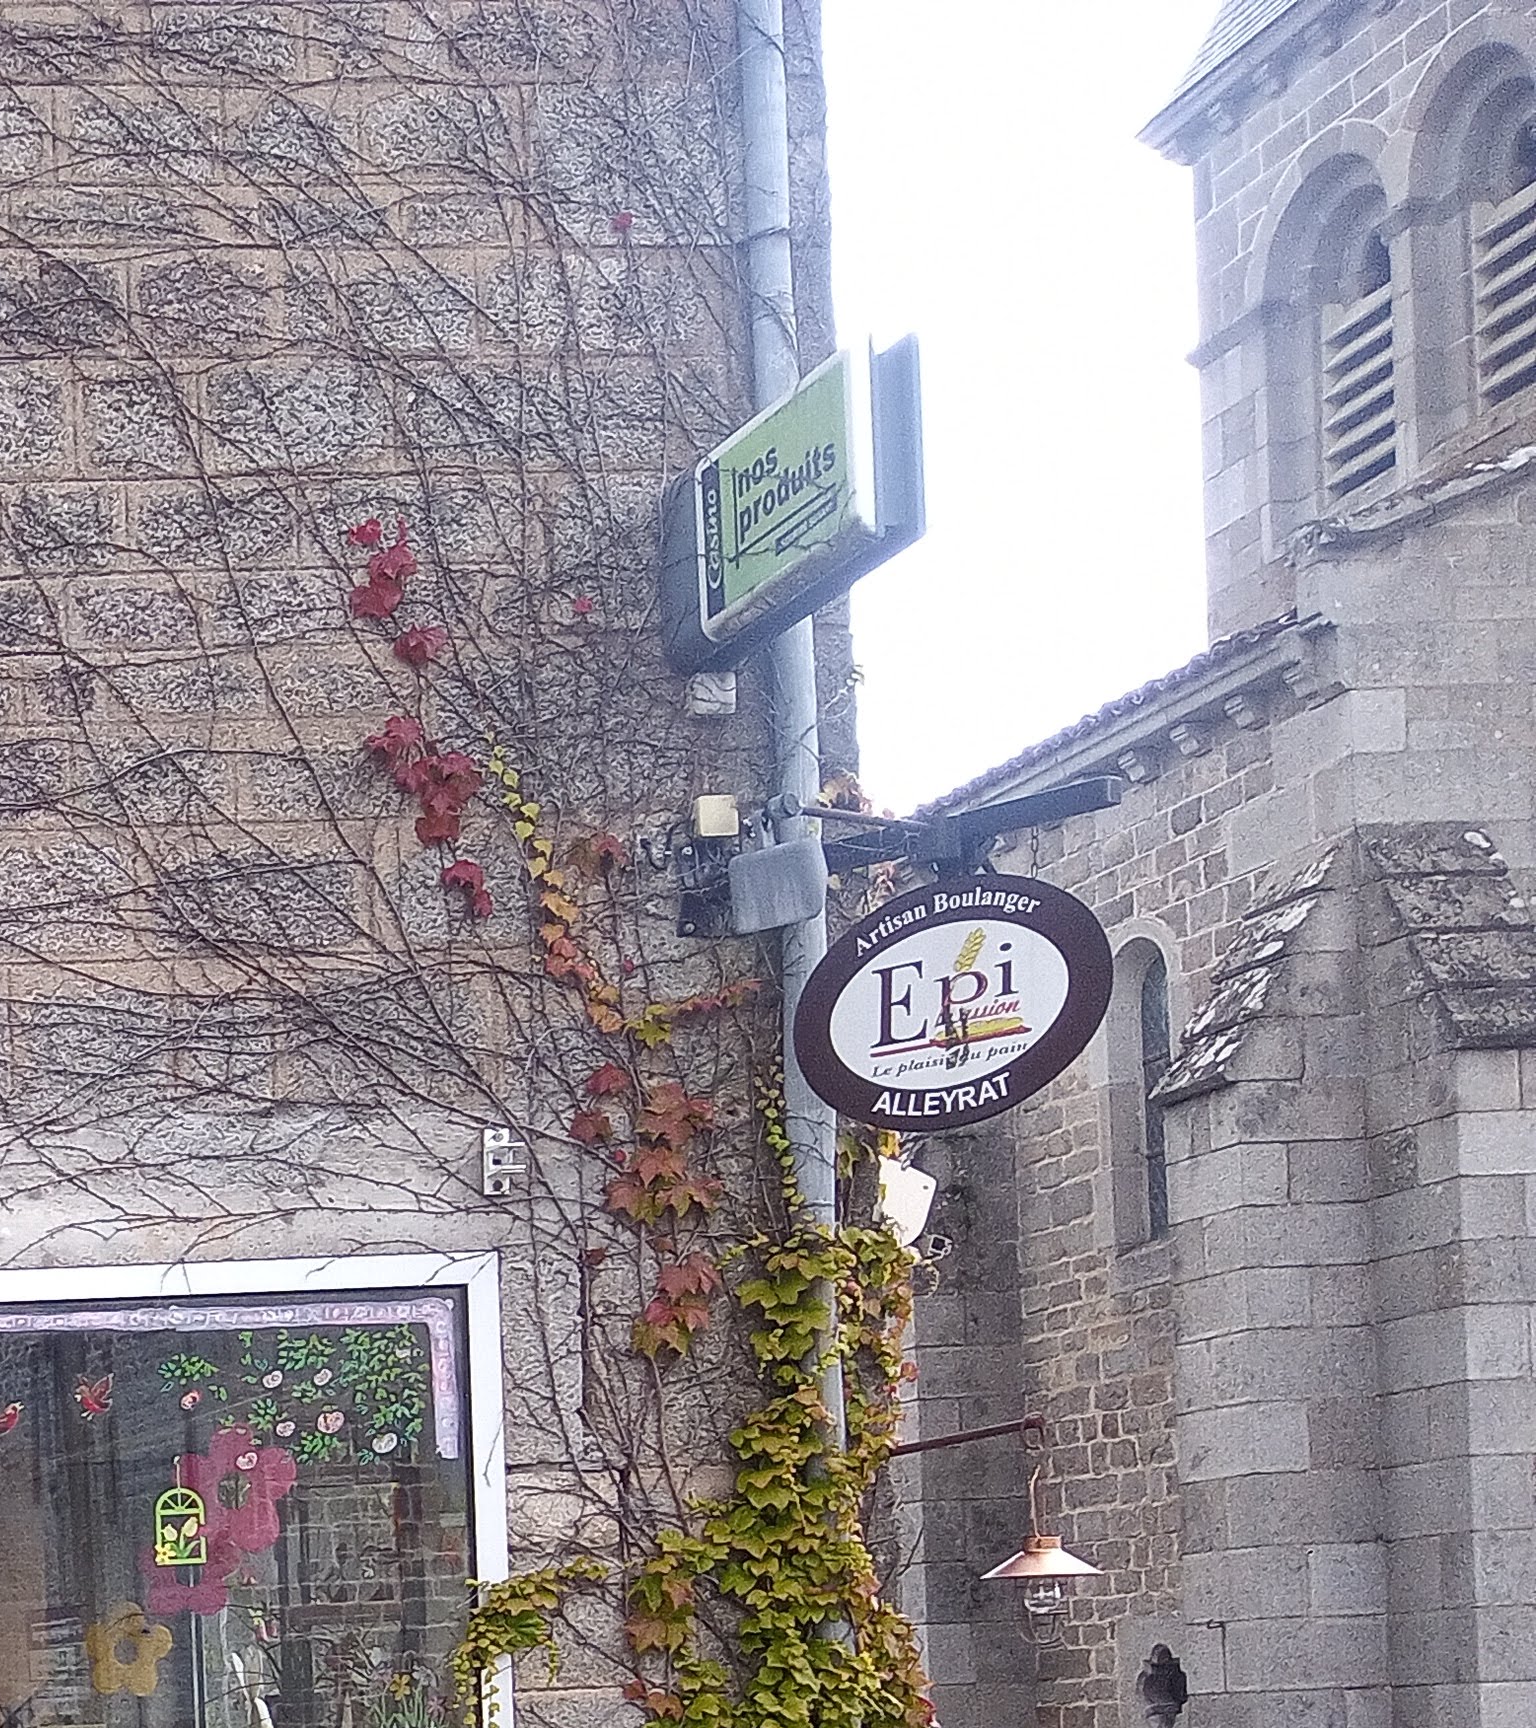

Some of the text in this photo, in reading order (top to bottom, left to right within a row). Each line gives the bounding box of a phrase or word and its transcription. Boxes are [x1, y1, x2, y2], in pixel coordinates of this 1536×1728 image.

[737, 446, 778, 498] nos
[738, 442, 836, 545] produits
[706, 489, 723, 590] Casino
[854, 886, 1041, 957] Artisan Boulanger
[871, 942, 1020, 1049] Epi
[871, 1066, 893, 1078] Le
[985, 1041, 1029, 1061] pain
[871, 1071, 1011, 1117] ALLEYRAT
